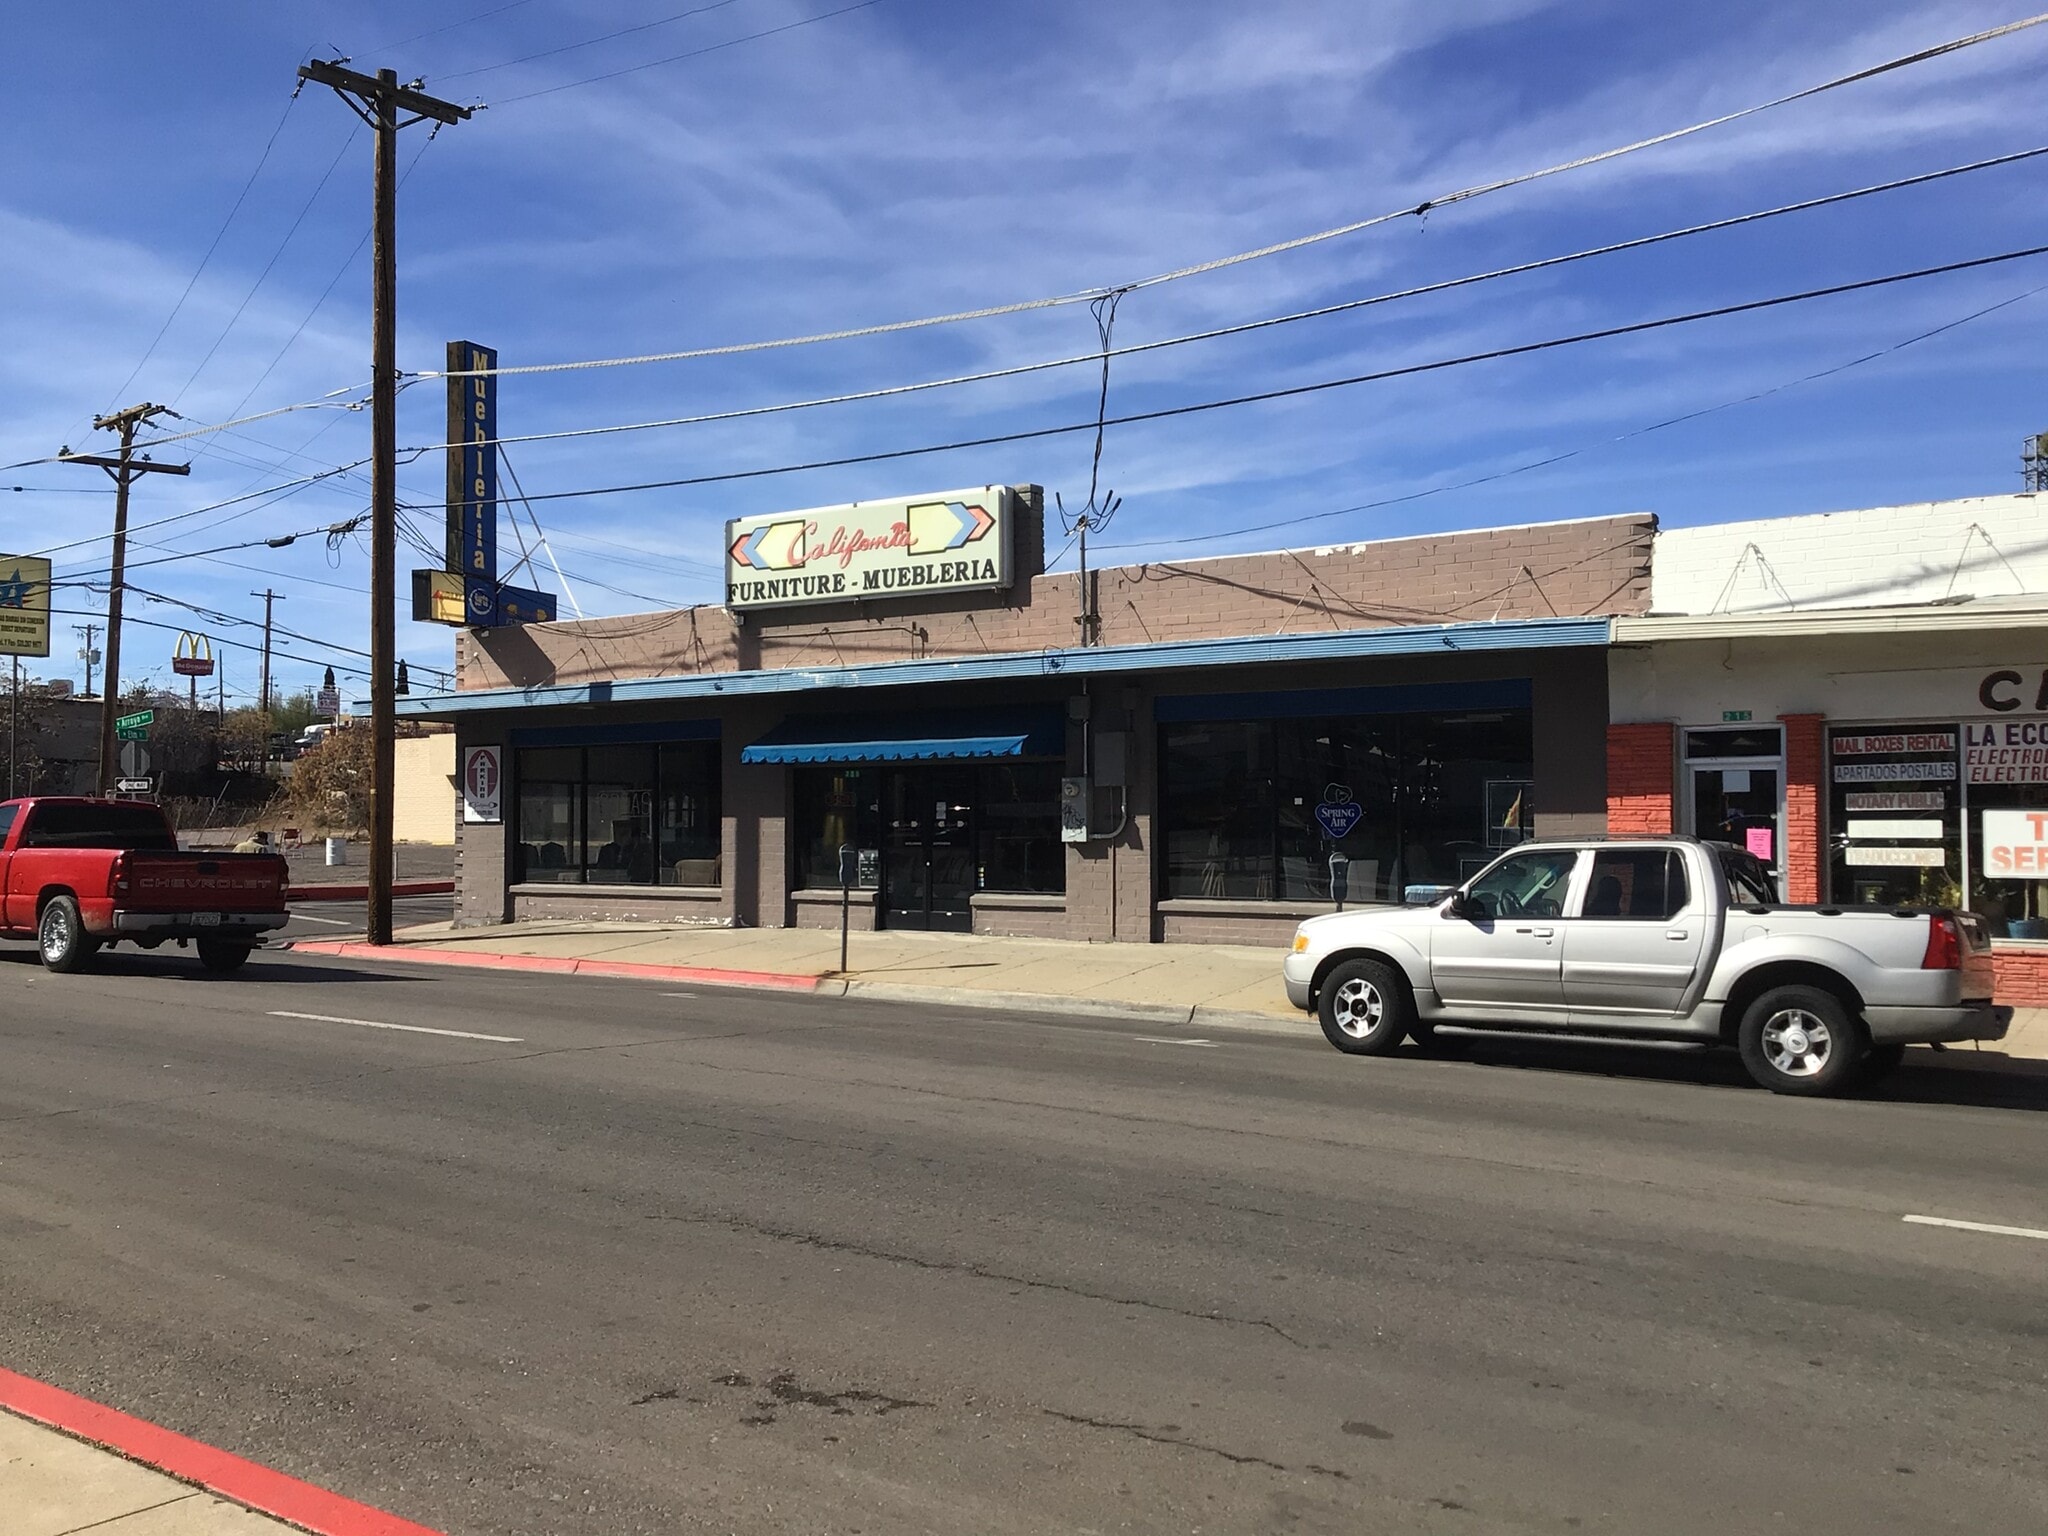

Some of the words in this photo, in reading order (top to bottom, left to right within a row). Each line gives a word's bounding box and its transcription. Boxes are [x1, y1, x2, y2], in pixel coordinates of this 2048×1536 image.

[472, 350, 489, 570] Muebleria
[727, 573, 846, 602] FURNITURE
[862, 558, 998, 591] MUEBLERIA
[121, 716, 141, 728] Arroyo
[1724, 711, 1750, 721] 215
[1834, 738, 1862, 753] MAIL
[1864, 736, 1904, 752] BOXES
[1907, 734, 1954, 751] RENTAL
[1966, 724, 1996, 747] LA
[1836, 765, 1898, 780] APARTADOS
[1900, 763, 1955, 779] POSTALES
[1848, 794, 1896, 809] NOTARY
[1897, 793, 1944, 808] PUBLIC
[1321, 807, 1355, 818] SPRING
[1330, 817, 1347, 827] AIR
[139, 878, 272, 889] CHEVROLET
